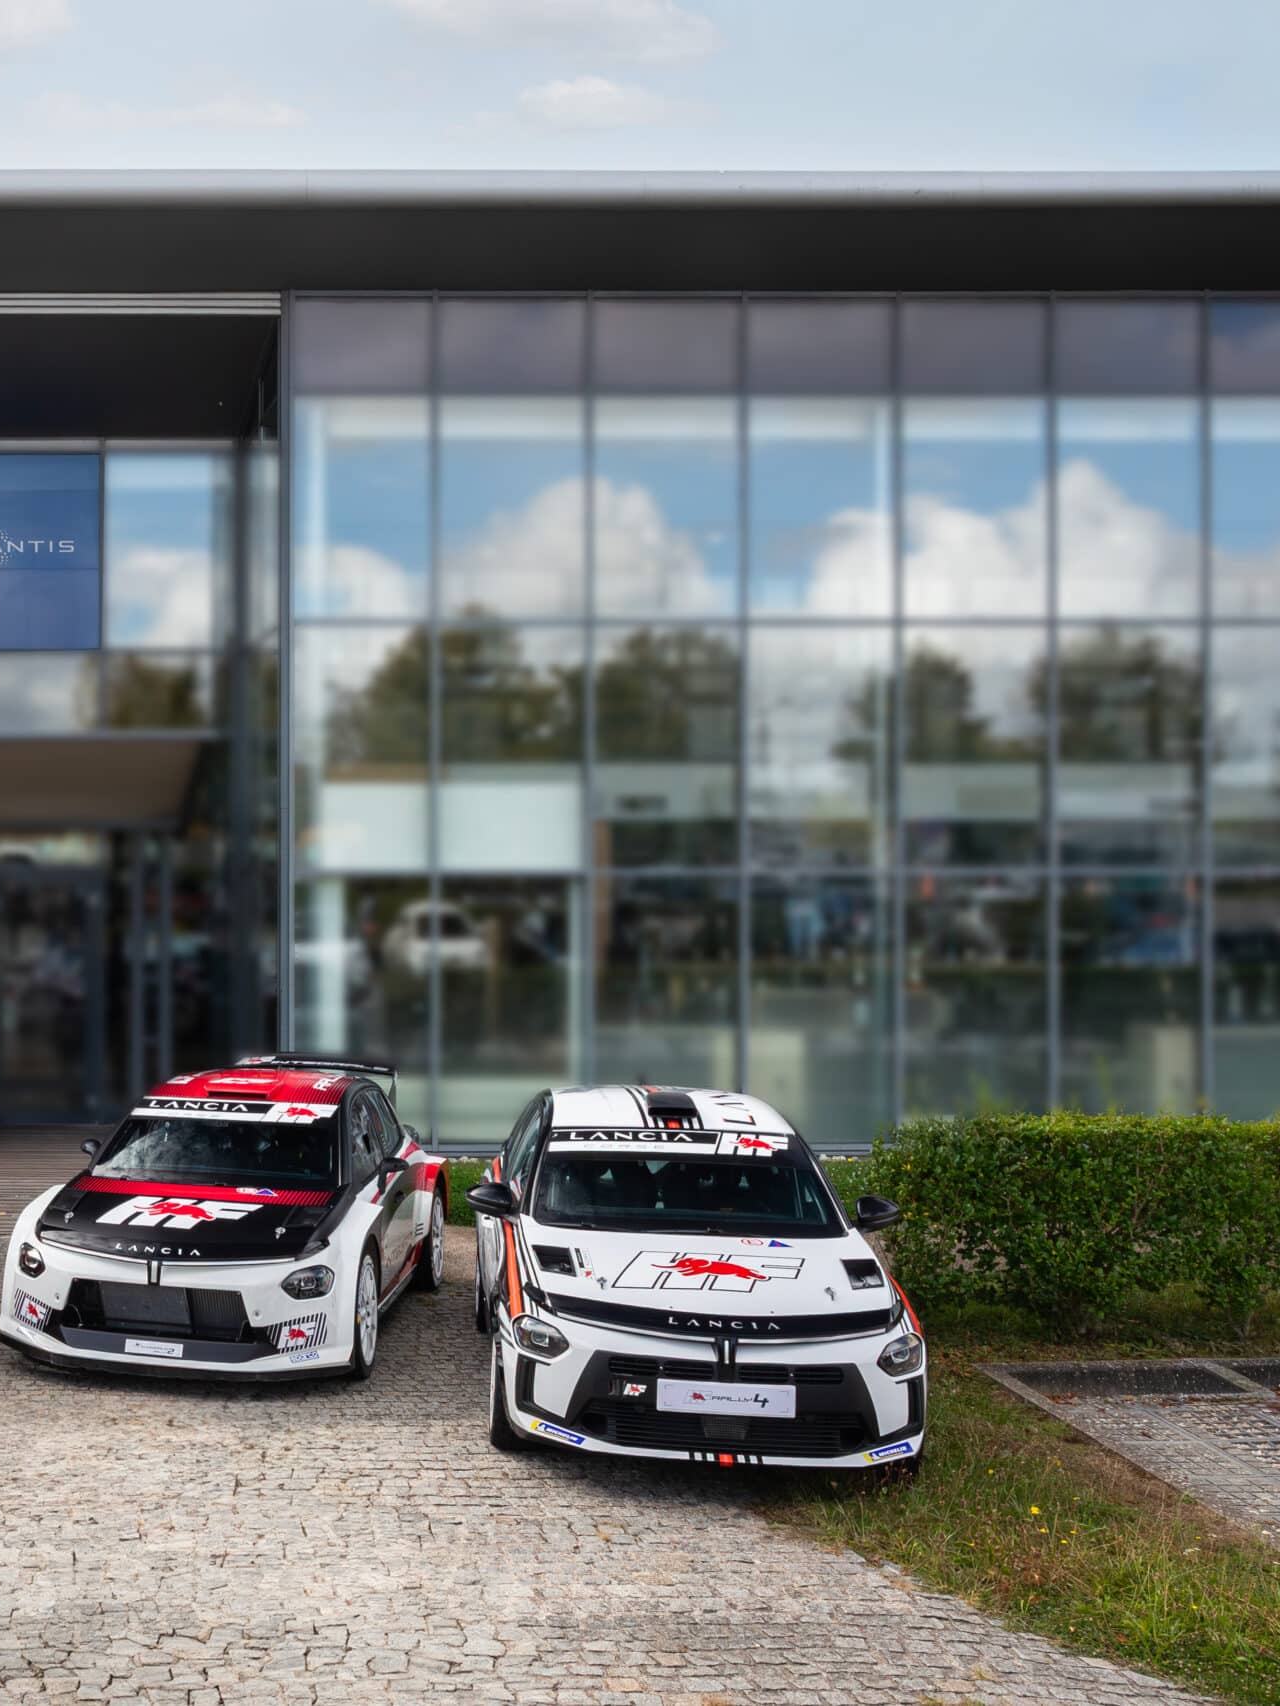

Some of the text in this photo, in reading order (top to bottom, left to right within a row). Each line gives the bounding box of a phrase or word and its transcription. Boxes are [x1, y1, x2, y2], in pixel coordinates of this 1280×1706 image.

[149, 1100, 249, 1112] LANCIA
[569, 1131, 693, 1142] LANCIA
[95, 1196, 264, 1230] HF
[115, 1243, 201, 1256] LANCIA
[669, 1316, 781, 1330] LANCIA
